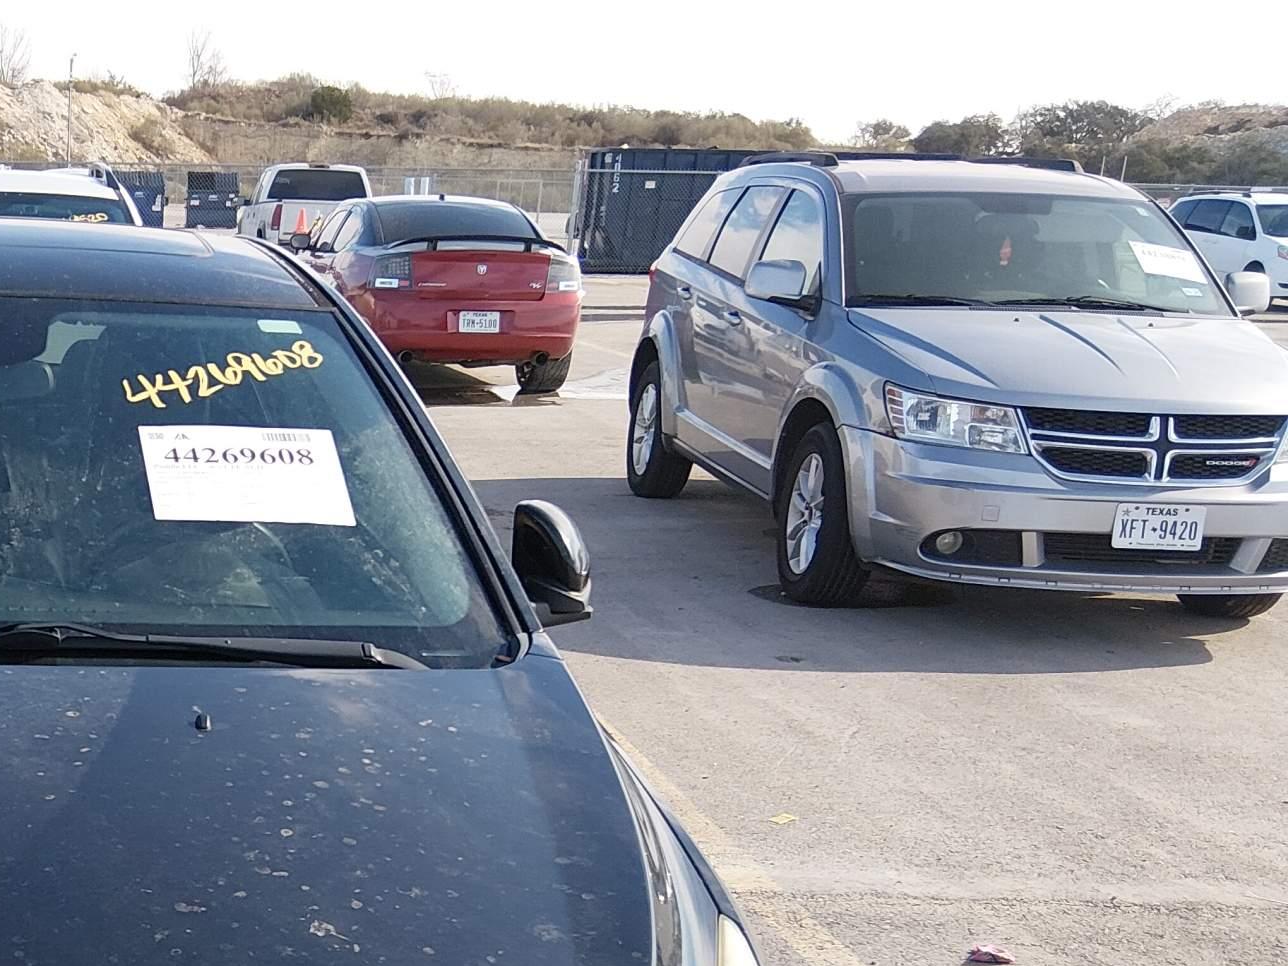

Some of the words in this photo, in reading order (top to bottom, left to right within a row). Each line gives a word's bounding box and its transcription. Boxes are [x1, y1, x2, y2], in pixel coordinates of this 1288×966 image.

[122, 340, 324, 408] 44269608
[163, 447, 315, 466] 44269608
[1145, 507, 1179, 517] TEXAS
